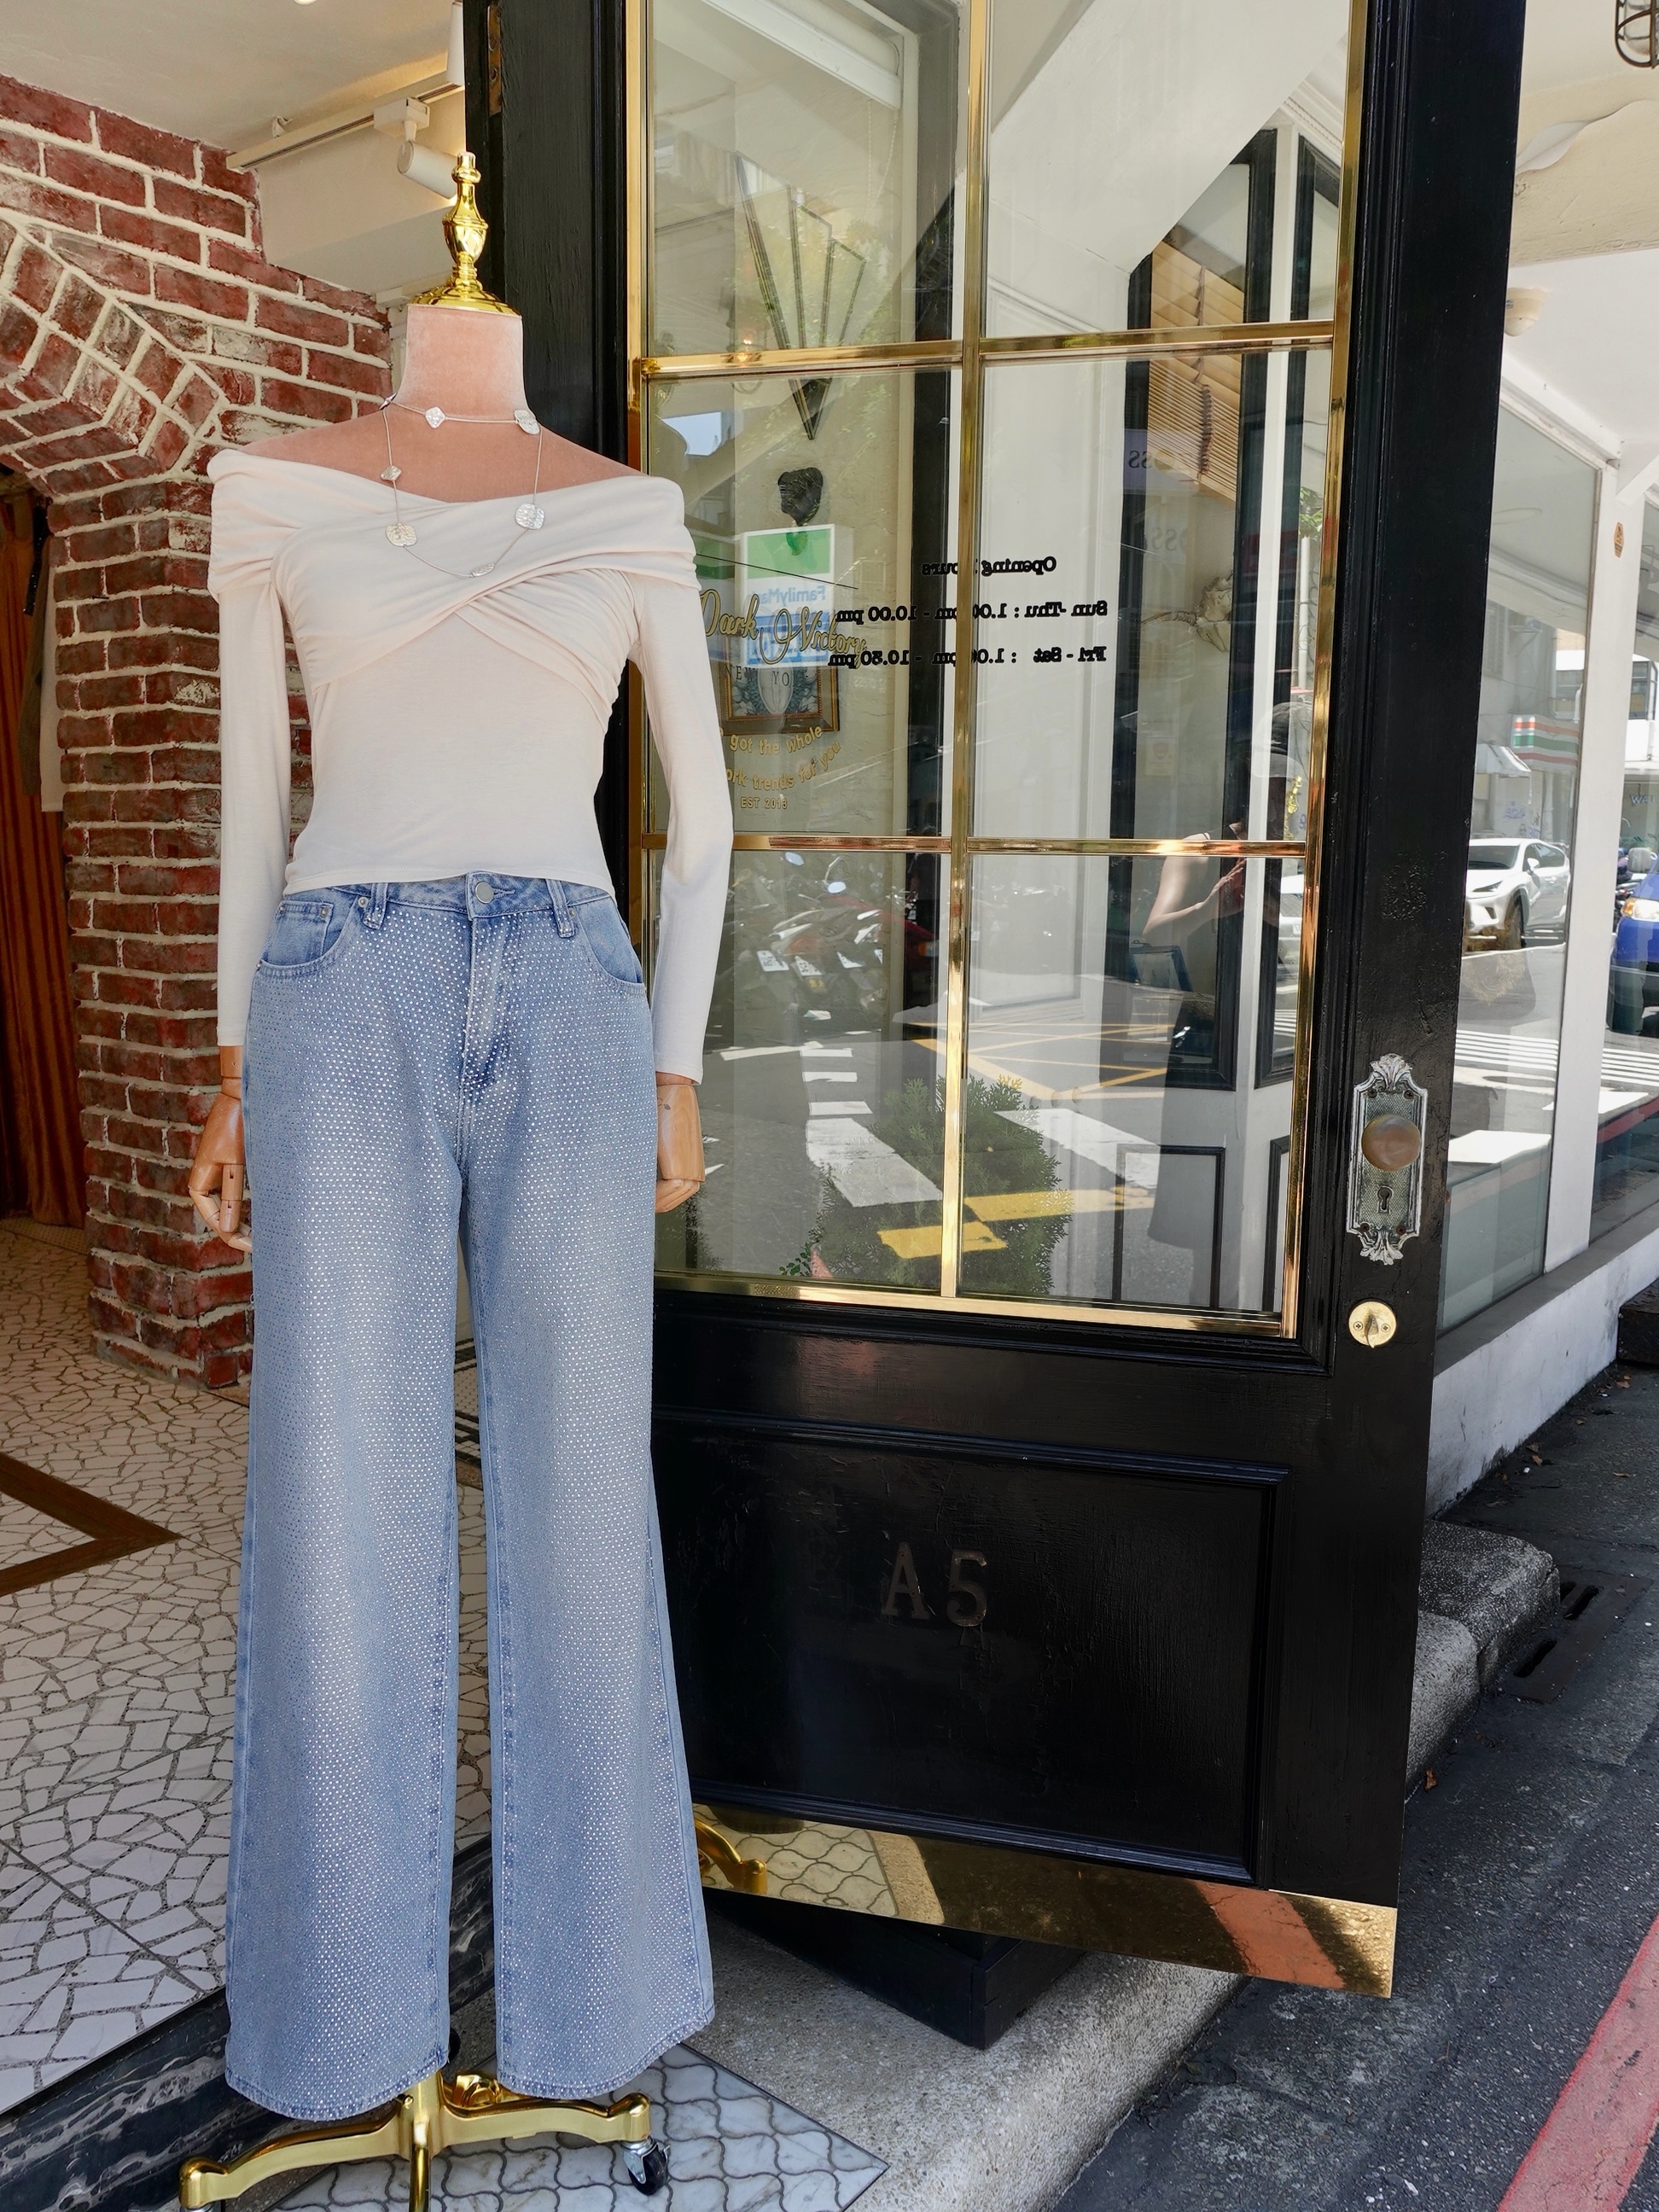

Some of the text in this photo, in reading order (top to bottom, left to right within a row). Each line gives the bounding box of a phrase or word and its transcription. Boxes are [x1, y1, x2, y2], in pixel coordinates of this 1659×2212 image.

[699, 589, 760, 640] Dark
[760, 606, 867, 670] Victory
[725, 740, 841, 791] ork trends for you
[730, 725, 823, 755] got the whole
[741, 797, 788, 809] EST 2013
[880, 1541, 987, 1627] A5
